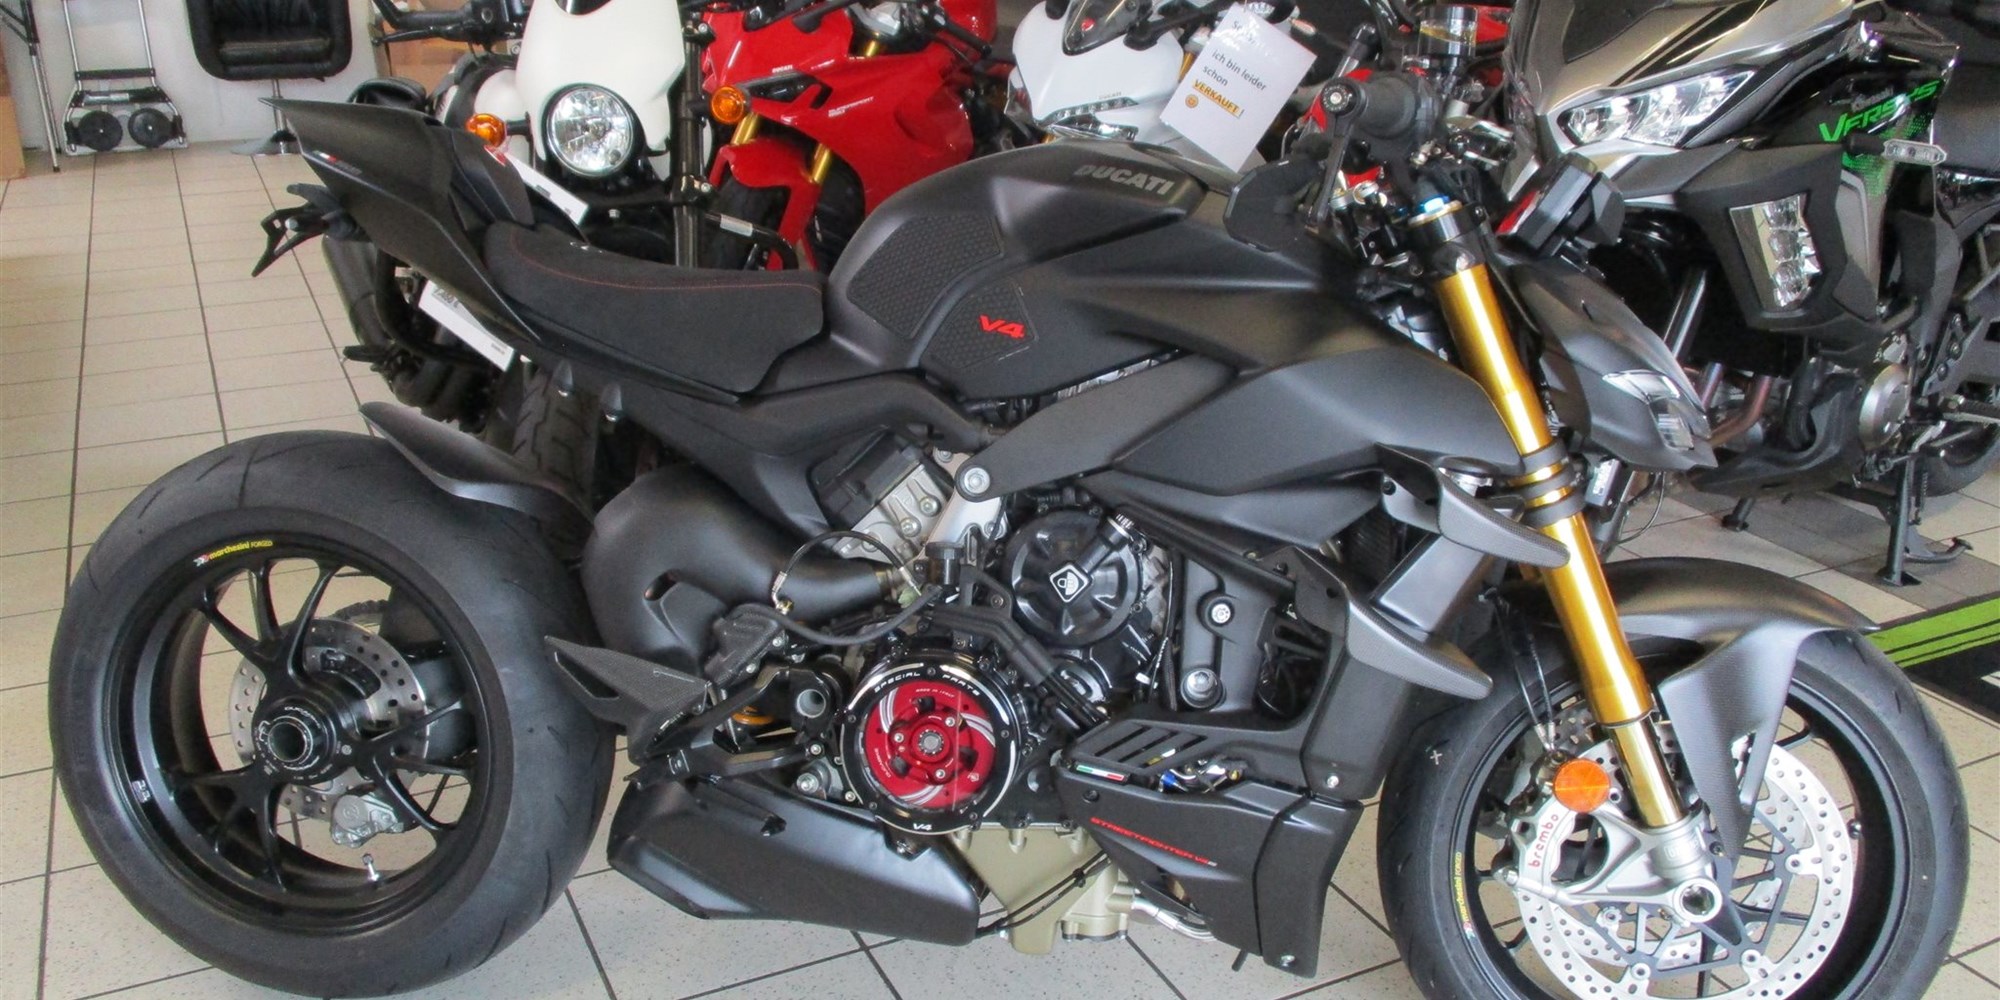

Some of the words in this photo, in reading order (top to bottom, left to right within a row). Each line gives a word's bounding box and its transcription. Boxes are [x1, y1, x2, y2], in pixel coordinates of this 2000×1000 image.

[1203, 66, 1228, 87] schon
[1212, 50, 1226, 64] ich
[1227, 60, 1241, 75] bin
[1241, 70, 1267, 92] leider
[1193, 79, 1239, 114] VERKAUFT
[1074, 164, 1176, 196] DUCATI
[980, 315, 1025, 338] V4
[209, 542, 250, 560] marchesini
[874, 671, 921, 693] SPECIAL
[942, 674, 980, 696] PARTS
[912, 823, 933, 831] V4
[1090, 817, 1193, 860] STREETFIGHTER
[1528, 814, 1559, 868] brembo
